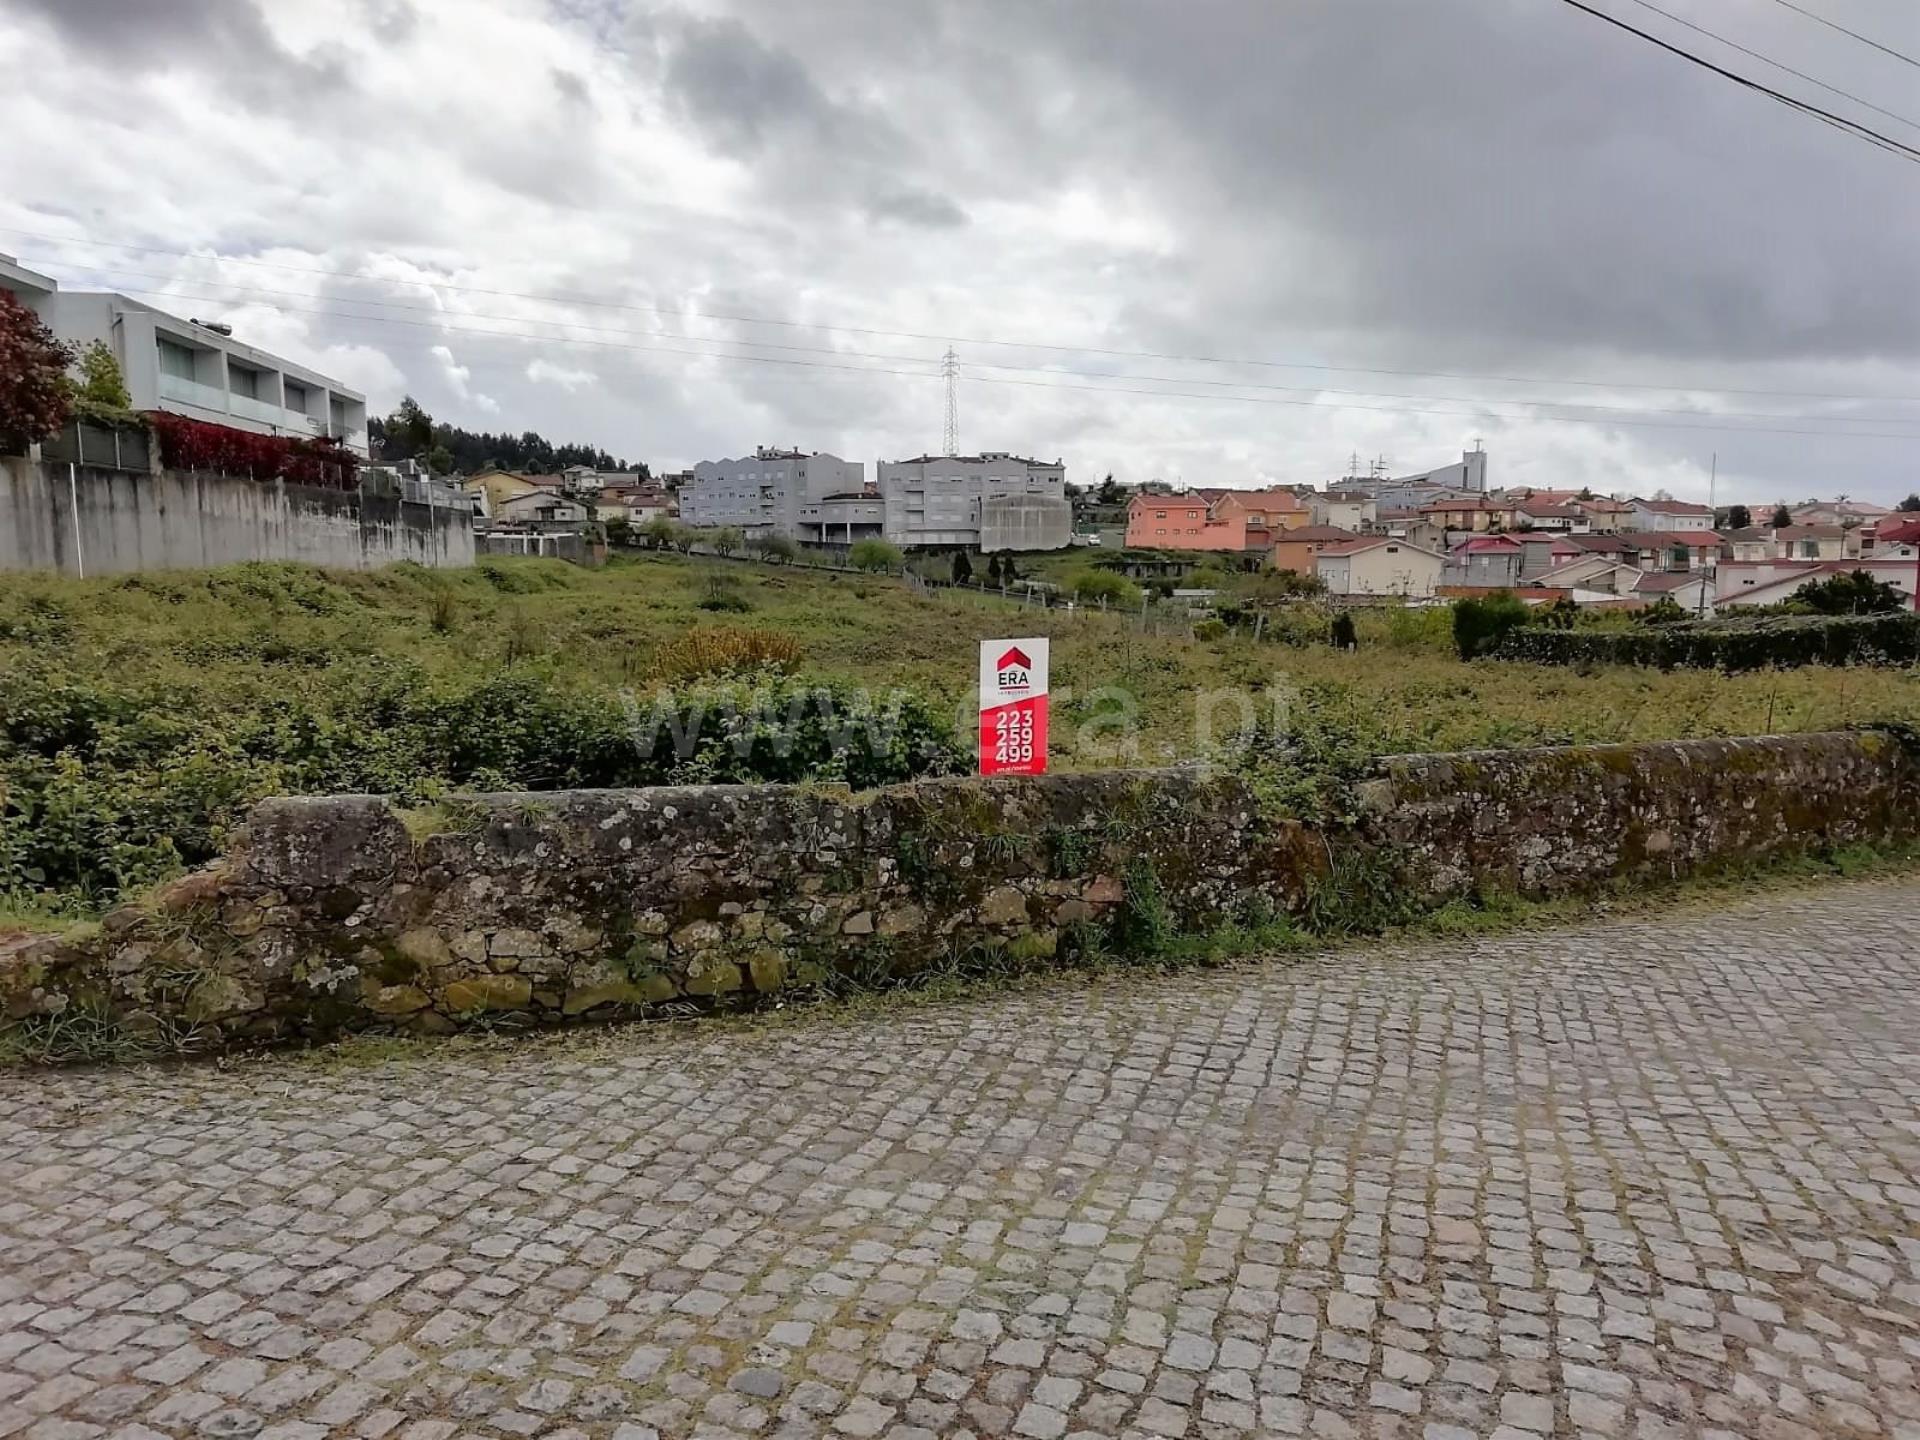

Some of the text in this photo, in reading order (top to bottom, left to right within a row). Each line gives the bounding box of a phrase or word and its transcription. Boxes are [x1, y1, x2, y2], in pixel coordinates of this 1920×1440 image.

[998, 672, 1029, 686] ERA
[996, 710, 1033, 729] 223
[996, 728, 1033, 747] 259
[995, 745, 1033, 764] 499
